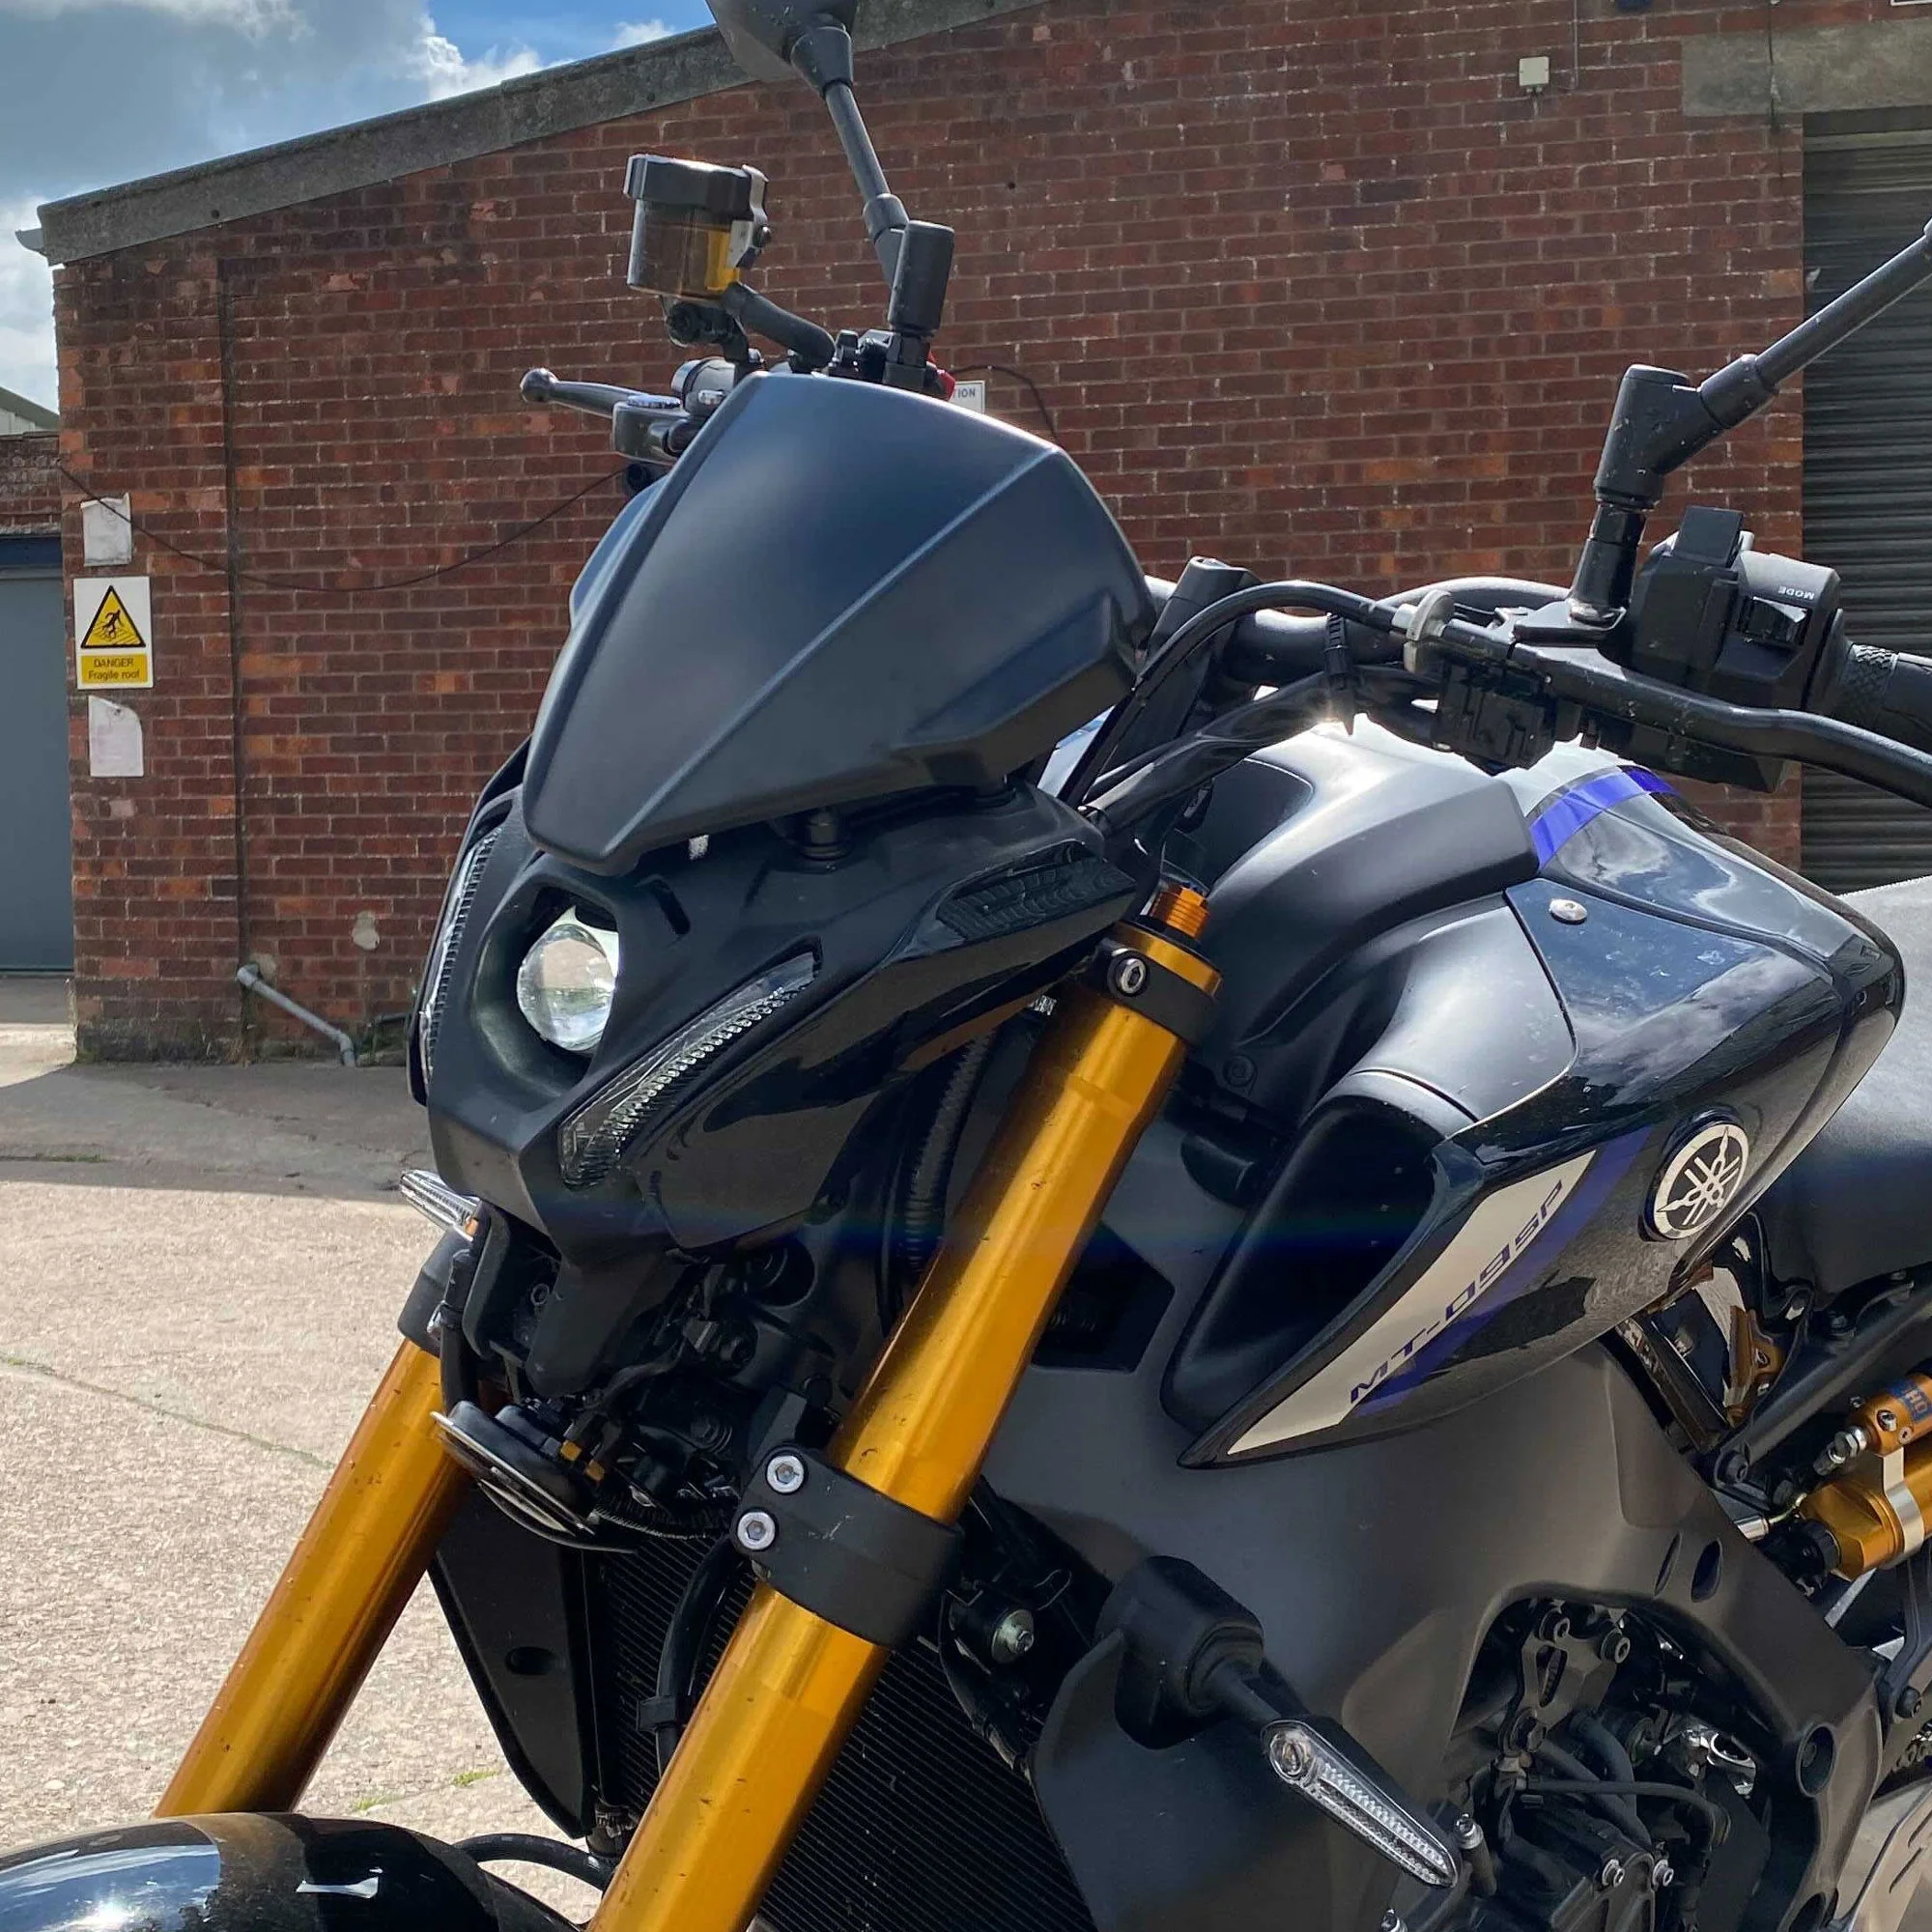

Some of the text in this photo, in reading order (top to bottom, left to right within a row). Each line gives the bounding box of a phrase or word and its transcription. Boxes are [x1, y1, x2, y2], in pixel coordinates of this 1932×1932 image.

[952, 387, 976, 398] ION
[1778, 585, 1815, 600] MODE
[94, 658, 134, 668] DANGER
[88, 668, 140, 680] Fragile roof
